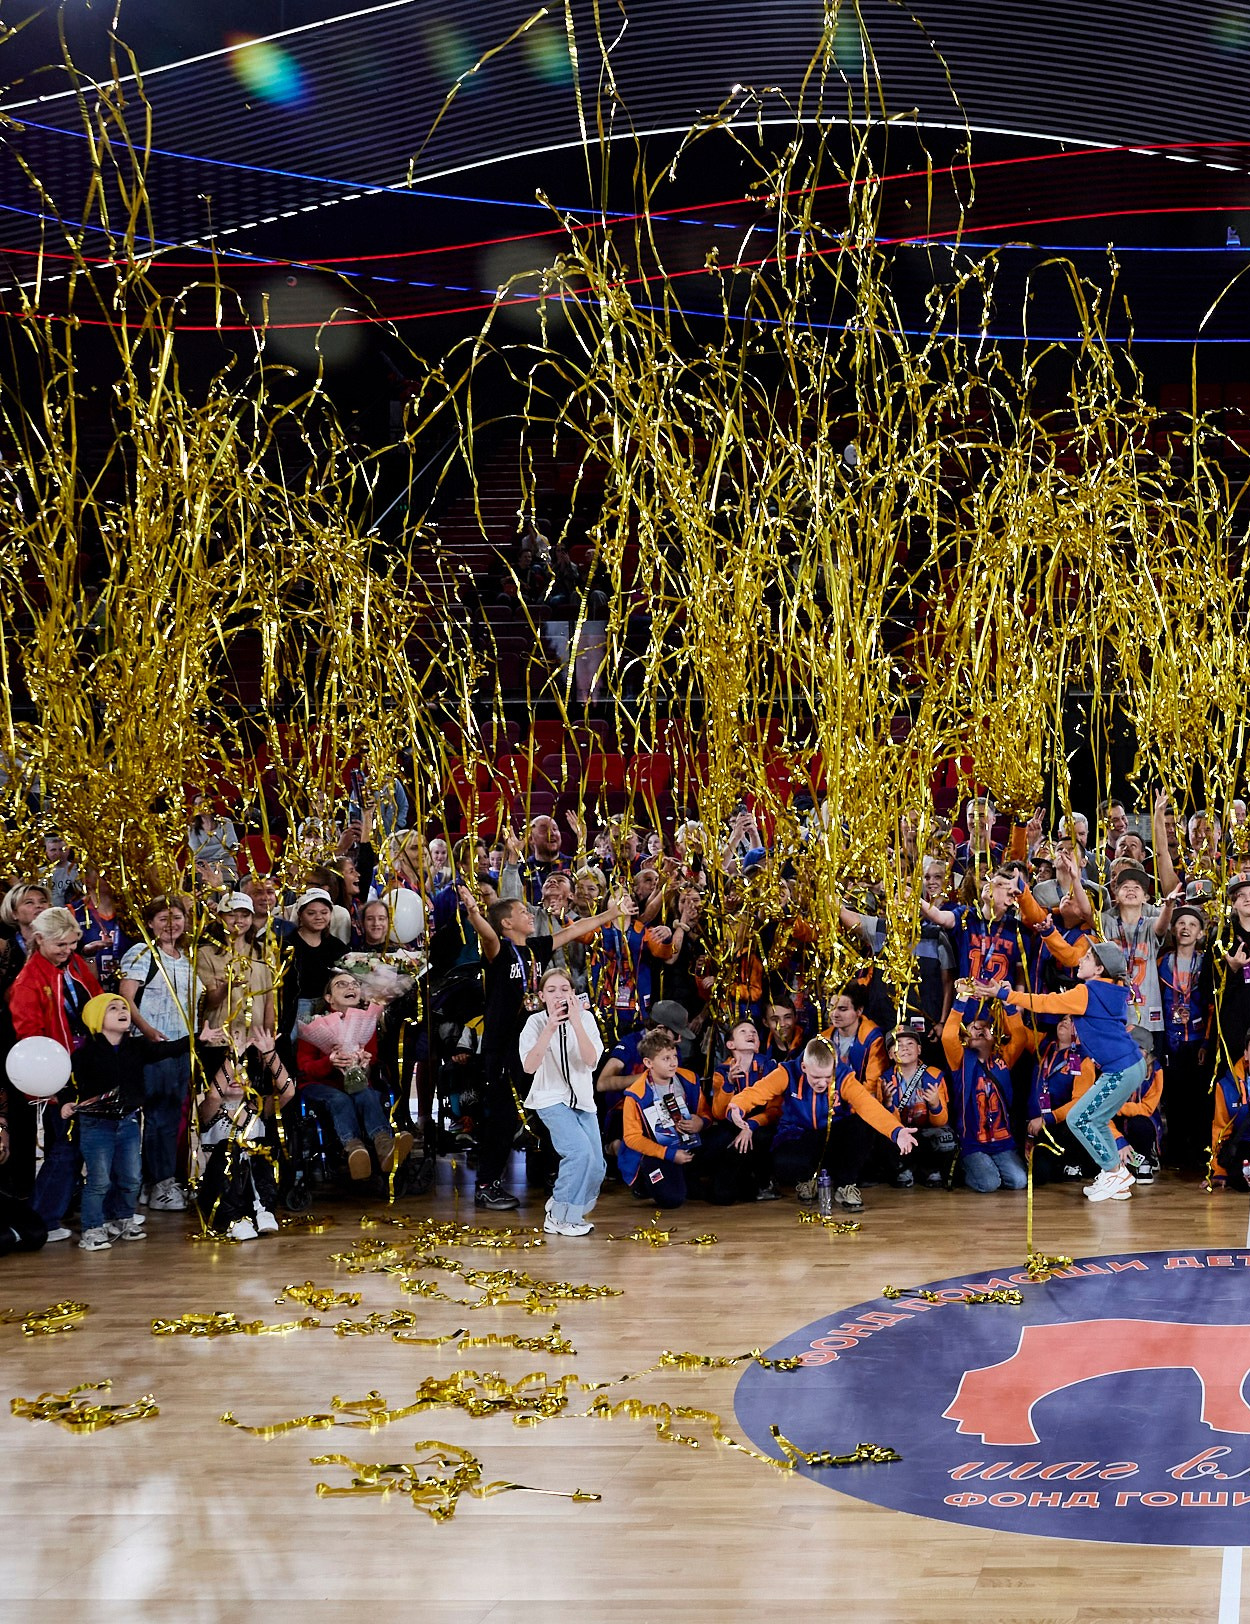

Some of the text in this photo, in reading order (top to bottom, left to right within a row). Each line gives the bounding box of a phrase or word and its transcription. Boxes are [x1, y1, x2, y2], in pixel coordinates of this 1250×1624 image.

[968, 948, 1009, 999] 12
[975, 1091, 1011, 1143] 12
[799, 1310, 915, 1366] ФОНД
[892, 1259, 1150, 1313] ПОМОЩИ
[947, 1461, 1140, 1480] шаг
[944, 1491, 1100, 1508] ФОНД
